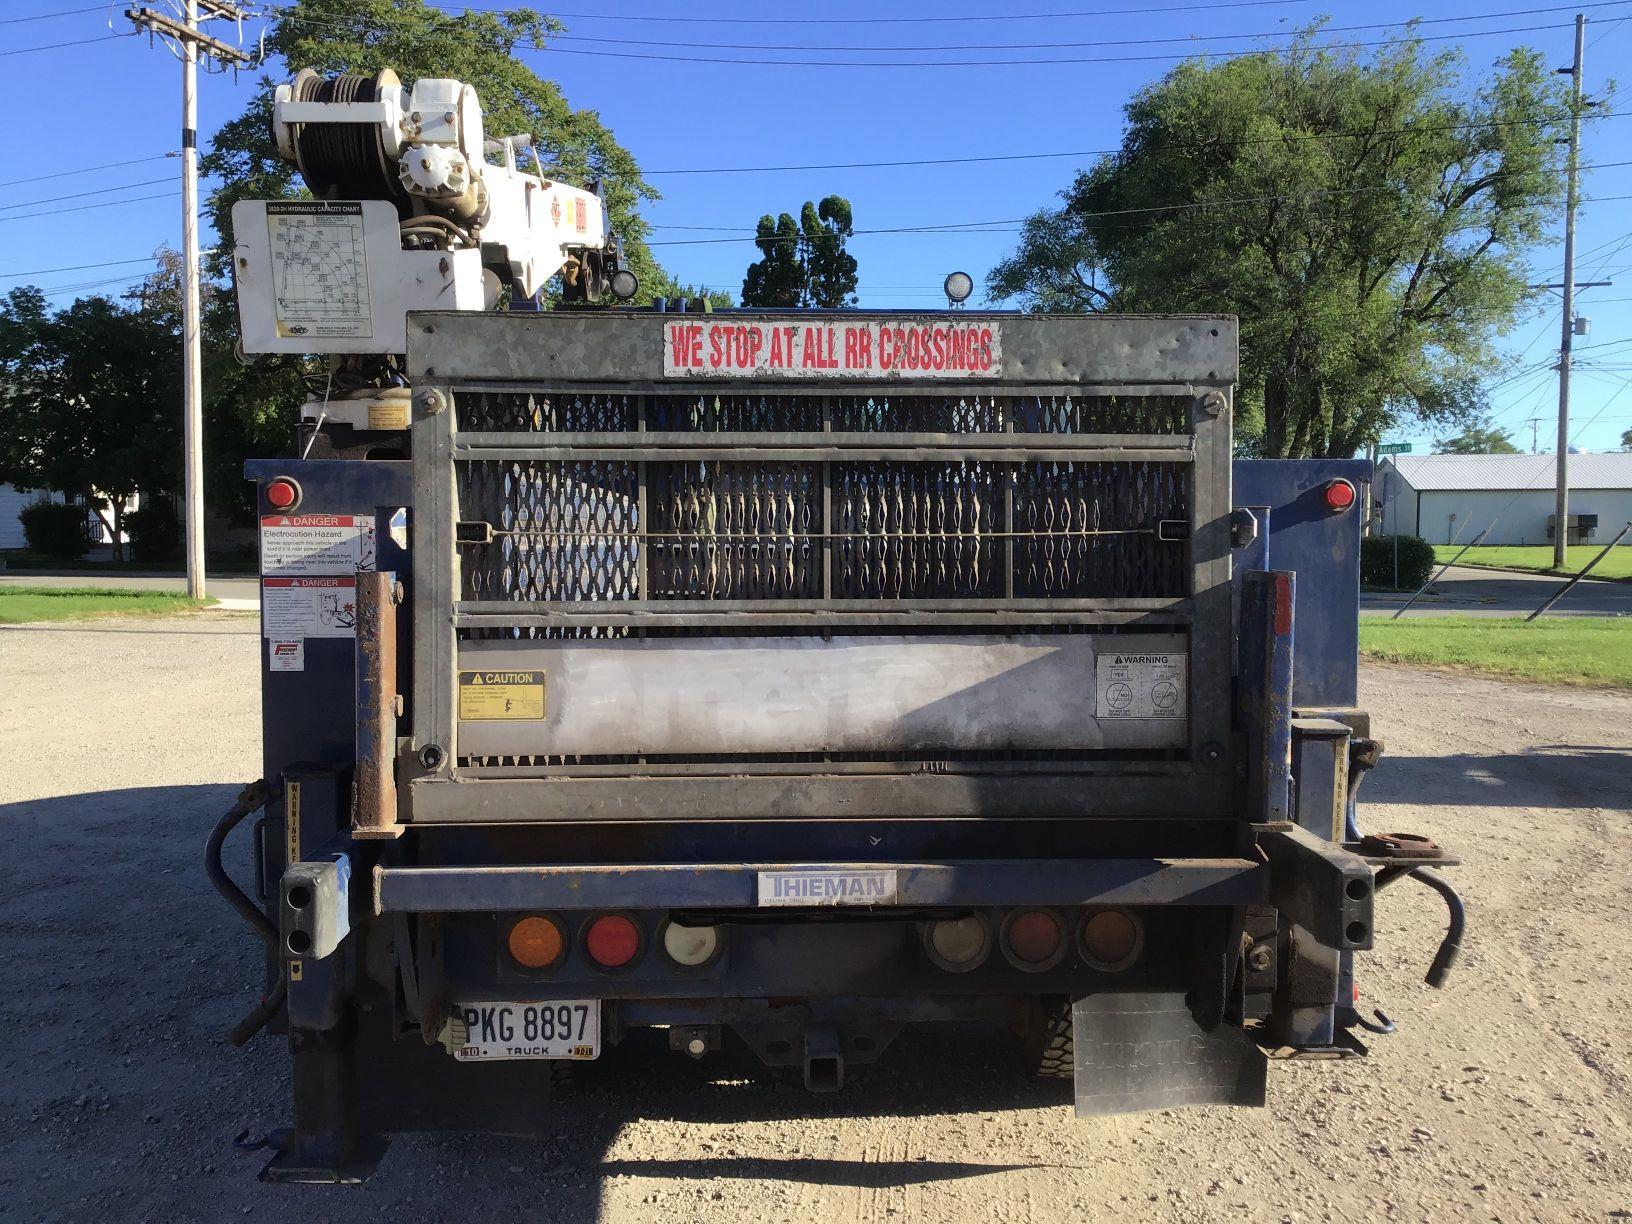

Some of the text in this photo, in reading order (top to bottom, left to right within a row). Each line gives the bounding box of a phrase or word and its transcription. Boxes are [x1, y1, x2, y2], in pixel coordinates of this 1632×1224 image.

[671, 325, 703, 367] WE
[709, 326, 763, 369] STOP
[770, 326, 795, 369] AT
[802, 327, 839, 369] ALL
[845, 327, 872, 370] RR
[293, 517, 339, 526] DANGER
[263, 530, 342, 538] Electrocution Hazard
[1124, 656, 1168, 664] WARNING
[485, 673, 533, 684] CAUTION
[766, 873, 885, 897] THIEMAN
[464, 1005, 589, 1043] PKG 8897
[506, 1047, 550, 1055] TRUCK
